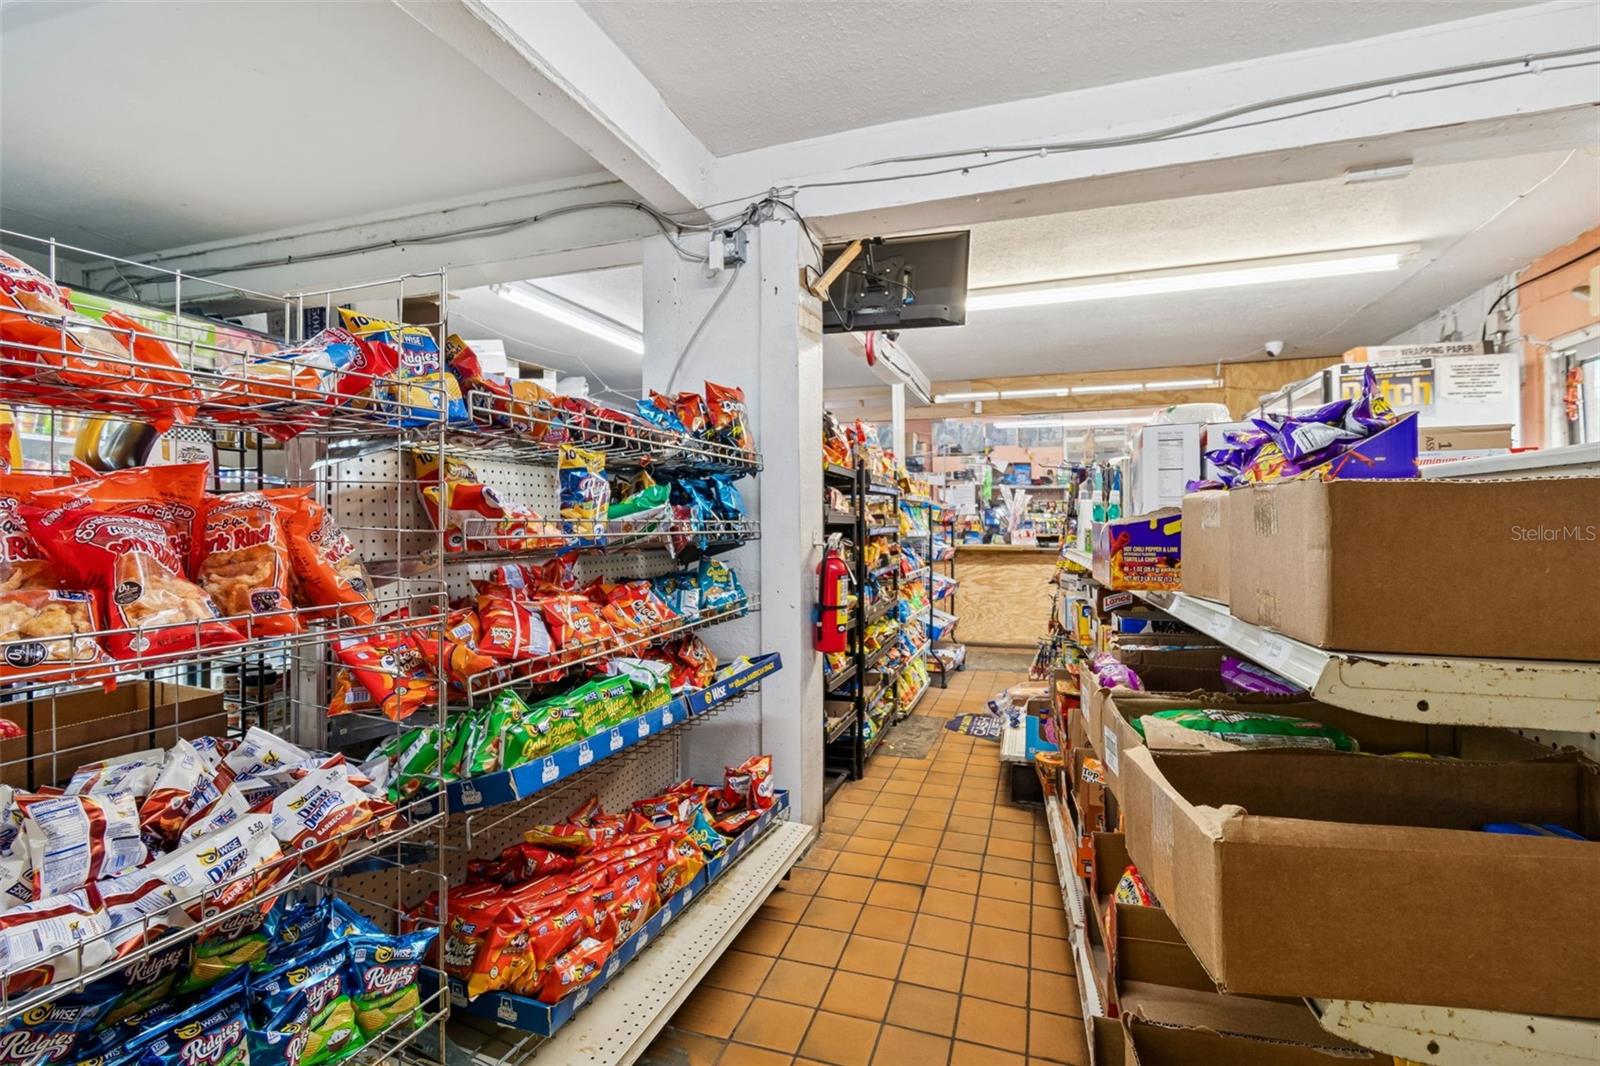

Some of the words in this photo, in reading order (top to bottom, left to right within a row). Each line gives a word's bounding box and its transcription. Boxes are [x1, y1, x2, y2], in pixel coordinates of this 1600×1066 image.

[350, 315, 369, 328] 10
[400, 352, 439, 375] idgies
[417, 454, 433, 465] 10
[1105, 594, 1131, 606] Lance
[1082, 767, 1099, 779] Top
[219, 838, 241, 856] WISE
[173, 872, 188, 884] 120
[125, 949, 184, 985] Ridgies
[365, 966, 417, 994] Ridgies
[51, 1008, 78, 1021] WISE
[201, 1012, 225, 1028] WISE
[181, 1021, 240, 1065] Ridgies
